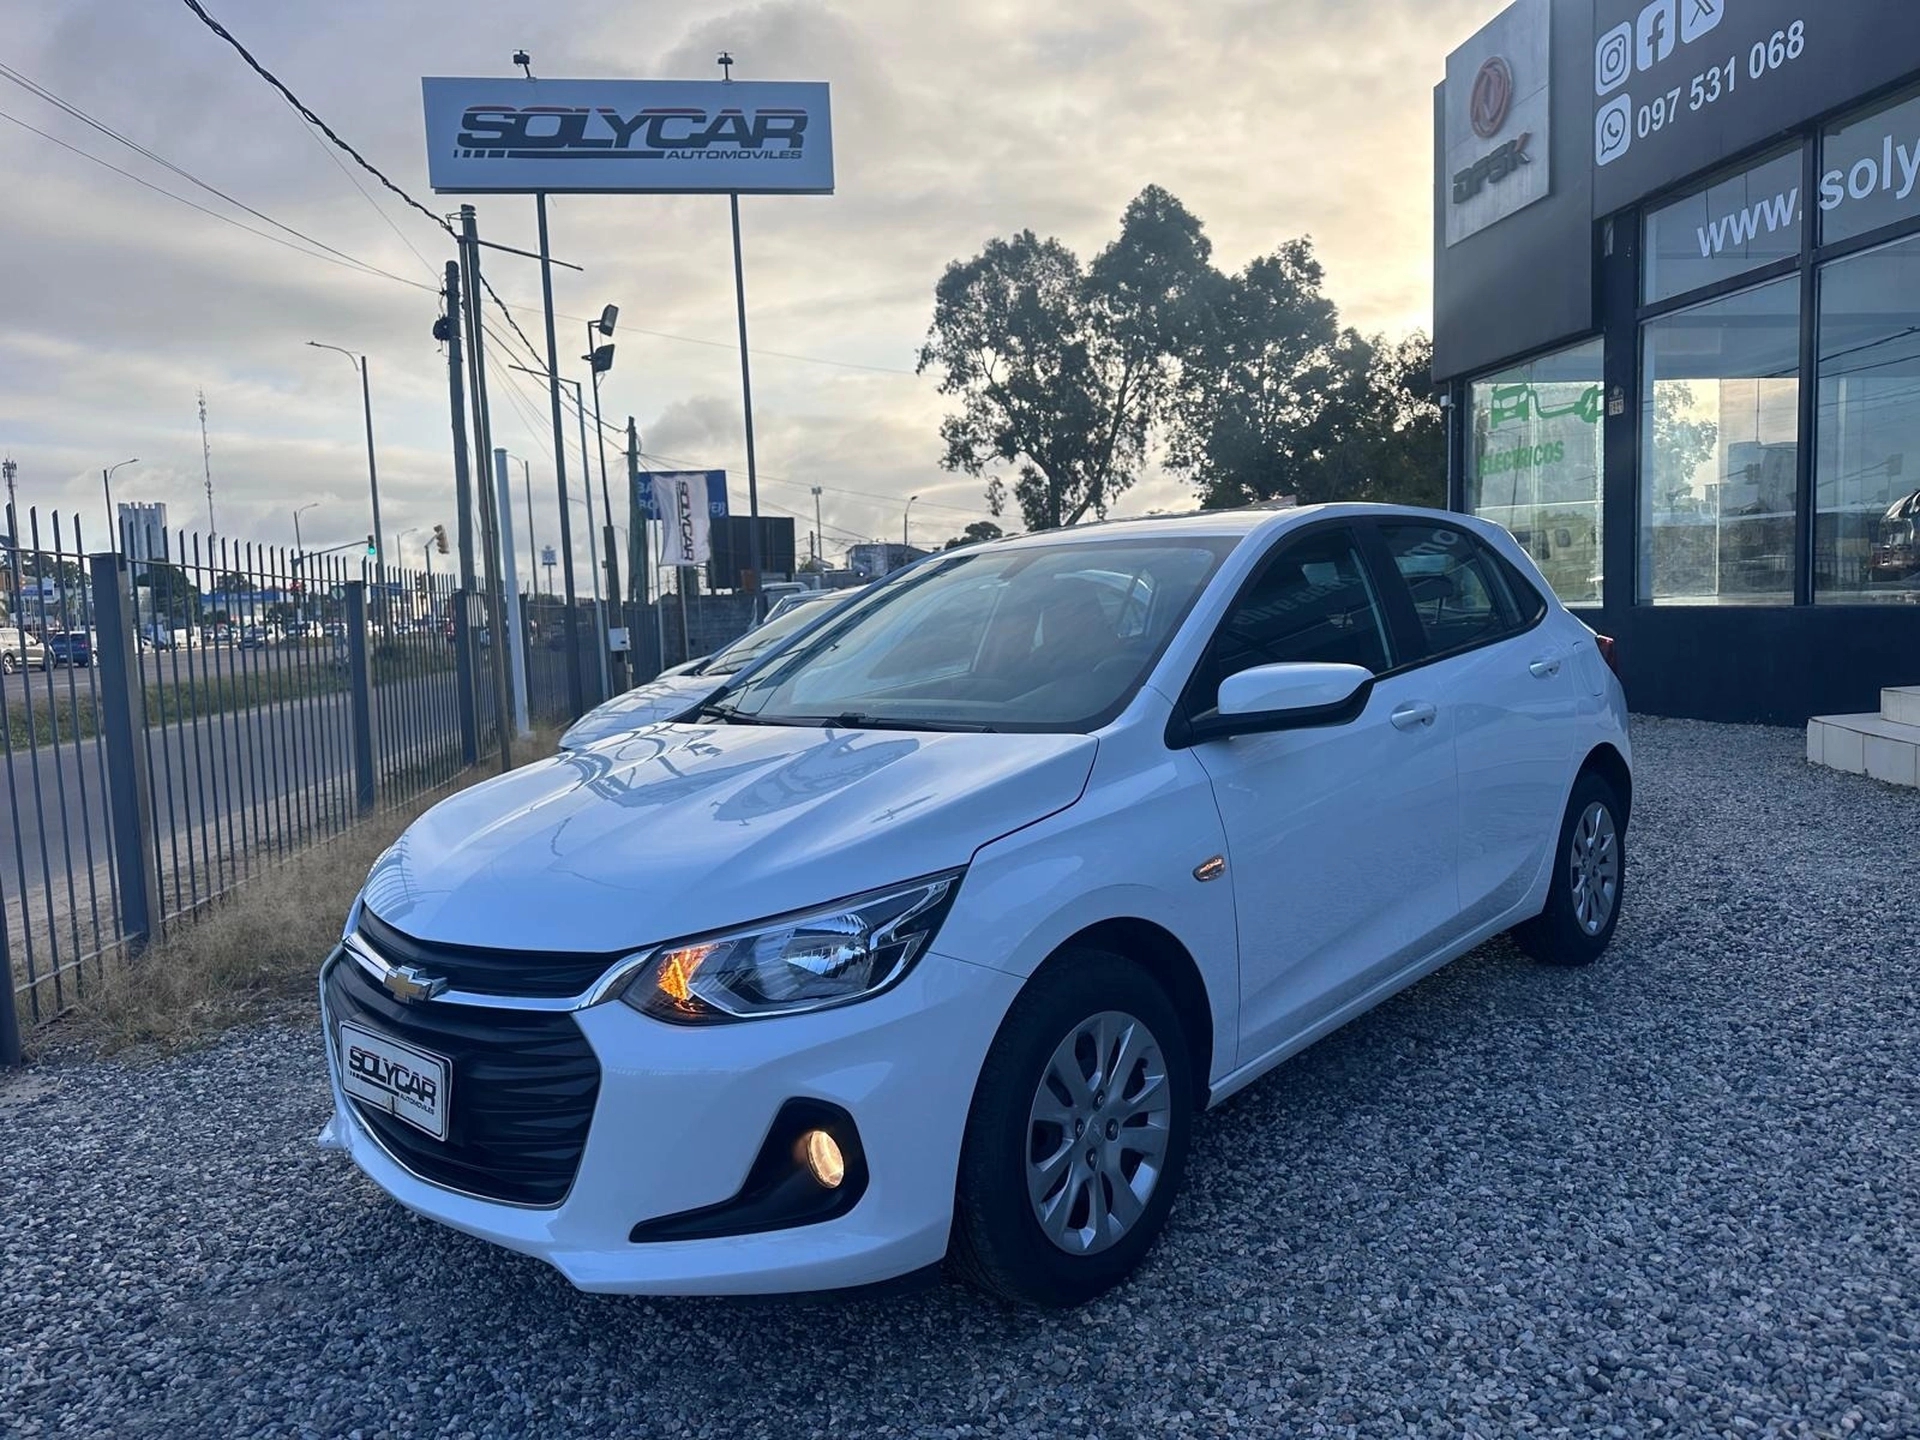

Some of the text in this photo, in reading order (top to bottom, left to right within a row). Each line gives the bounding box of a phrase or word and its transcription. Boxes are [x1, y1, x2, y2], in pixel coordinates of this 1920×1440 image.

[1637, 19, 1804, 138] 097 531 068
[457, 105, 808, 149] SOLYCAR
[666, 149, 803, 160] AUTOMOVILES
[680, 481, 695, 561] SOLYCAR
[349, 1045, 437, 1108] SOLYCAR
